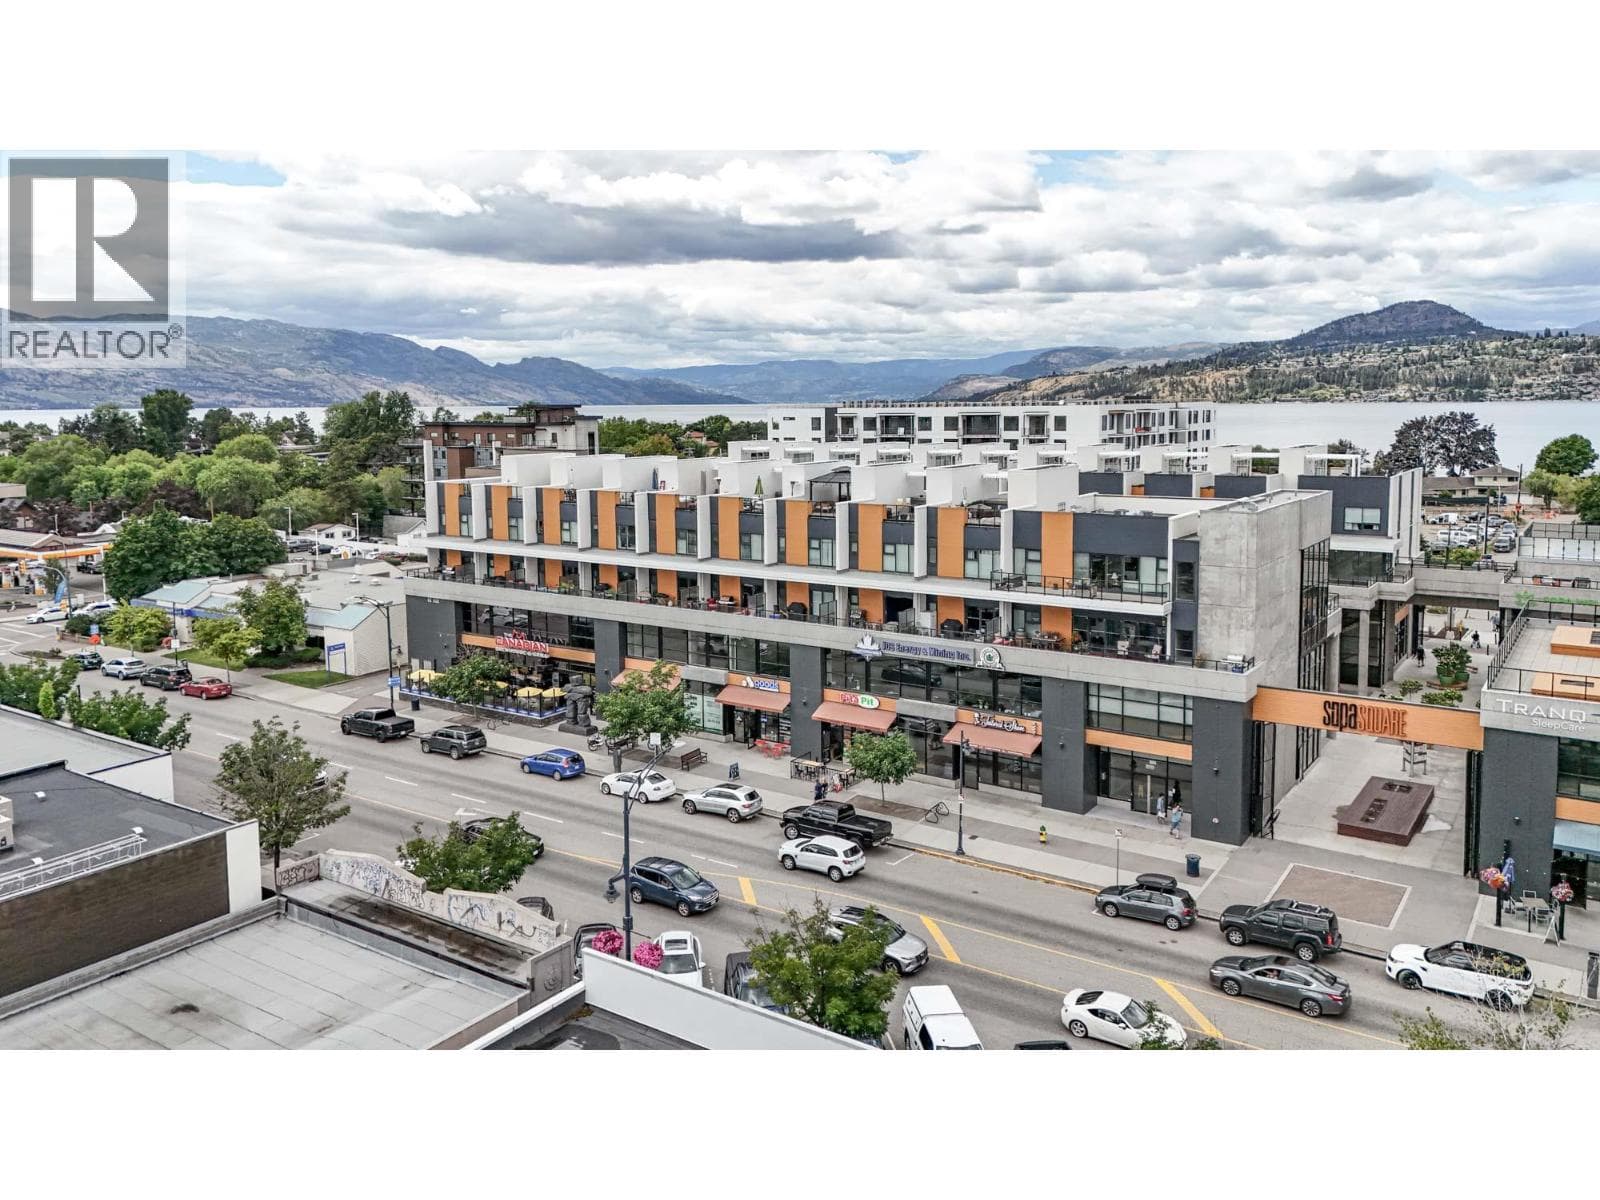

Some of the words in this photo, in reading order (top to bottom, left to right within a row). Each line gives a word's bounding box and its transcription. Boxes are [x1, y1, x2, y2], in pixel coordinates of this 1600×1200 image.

[495, 635, 549, 654] CANADIAN
[754, 679, 779, 689] goods
[861, 696, 874, 706] Pit
[1496, 698, 1586, 724] TRANQ
[1358, 704, 1408, 738] SQUARE
[1532, 717, 1585, 732] SleepCare
